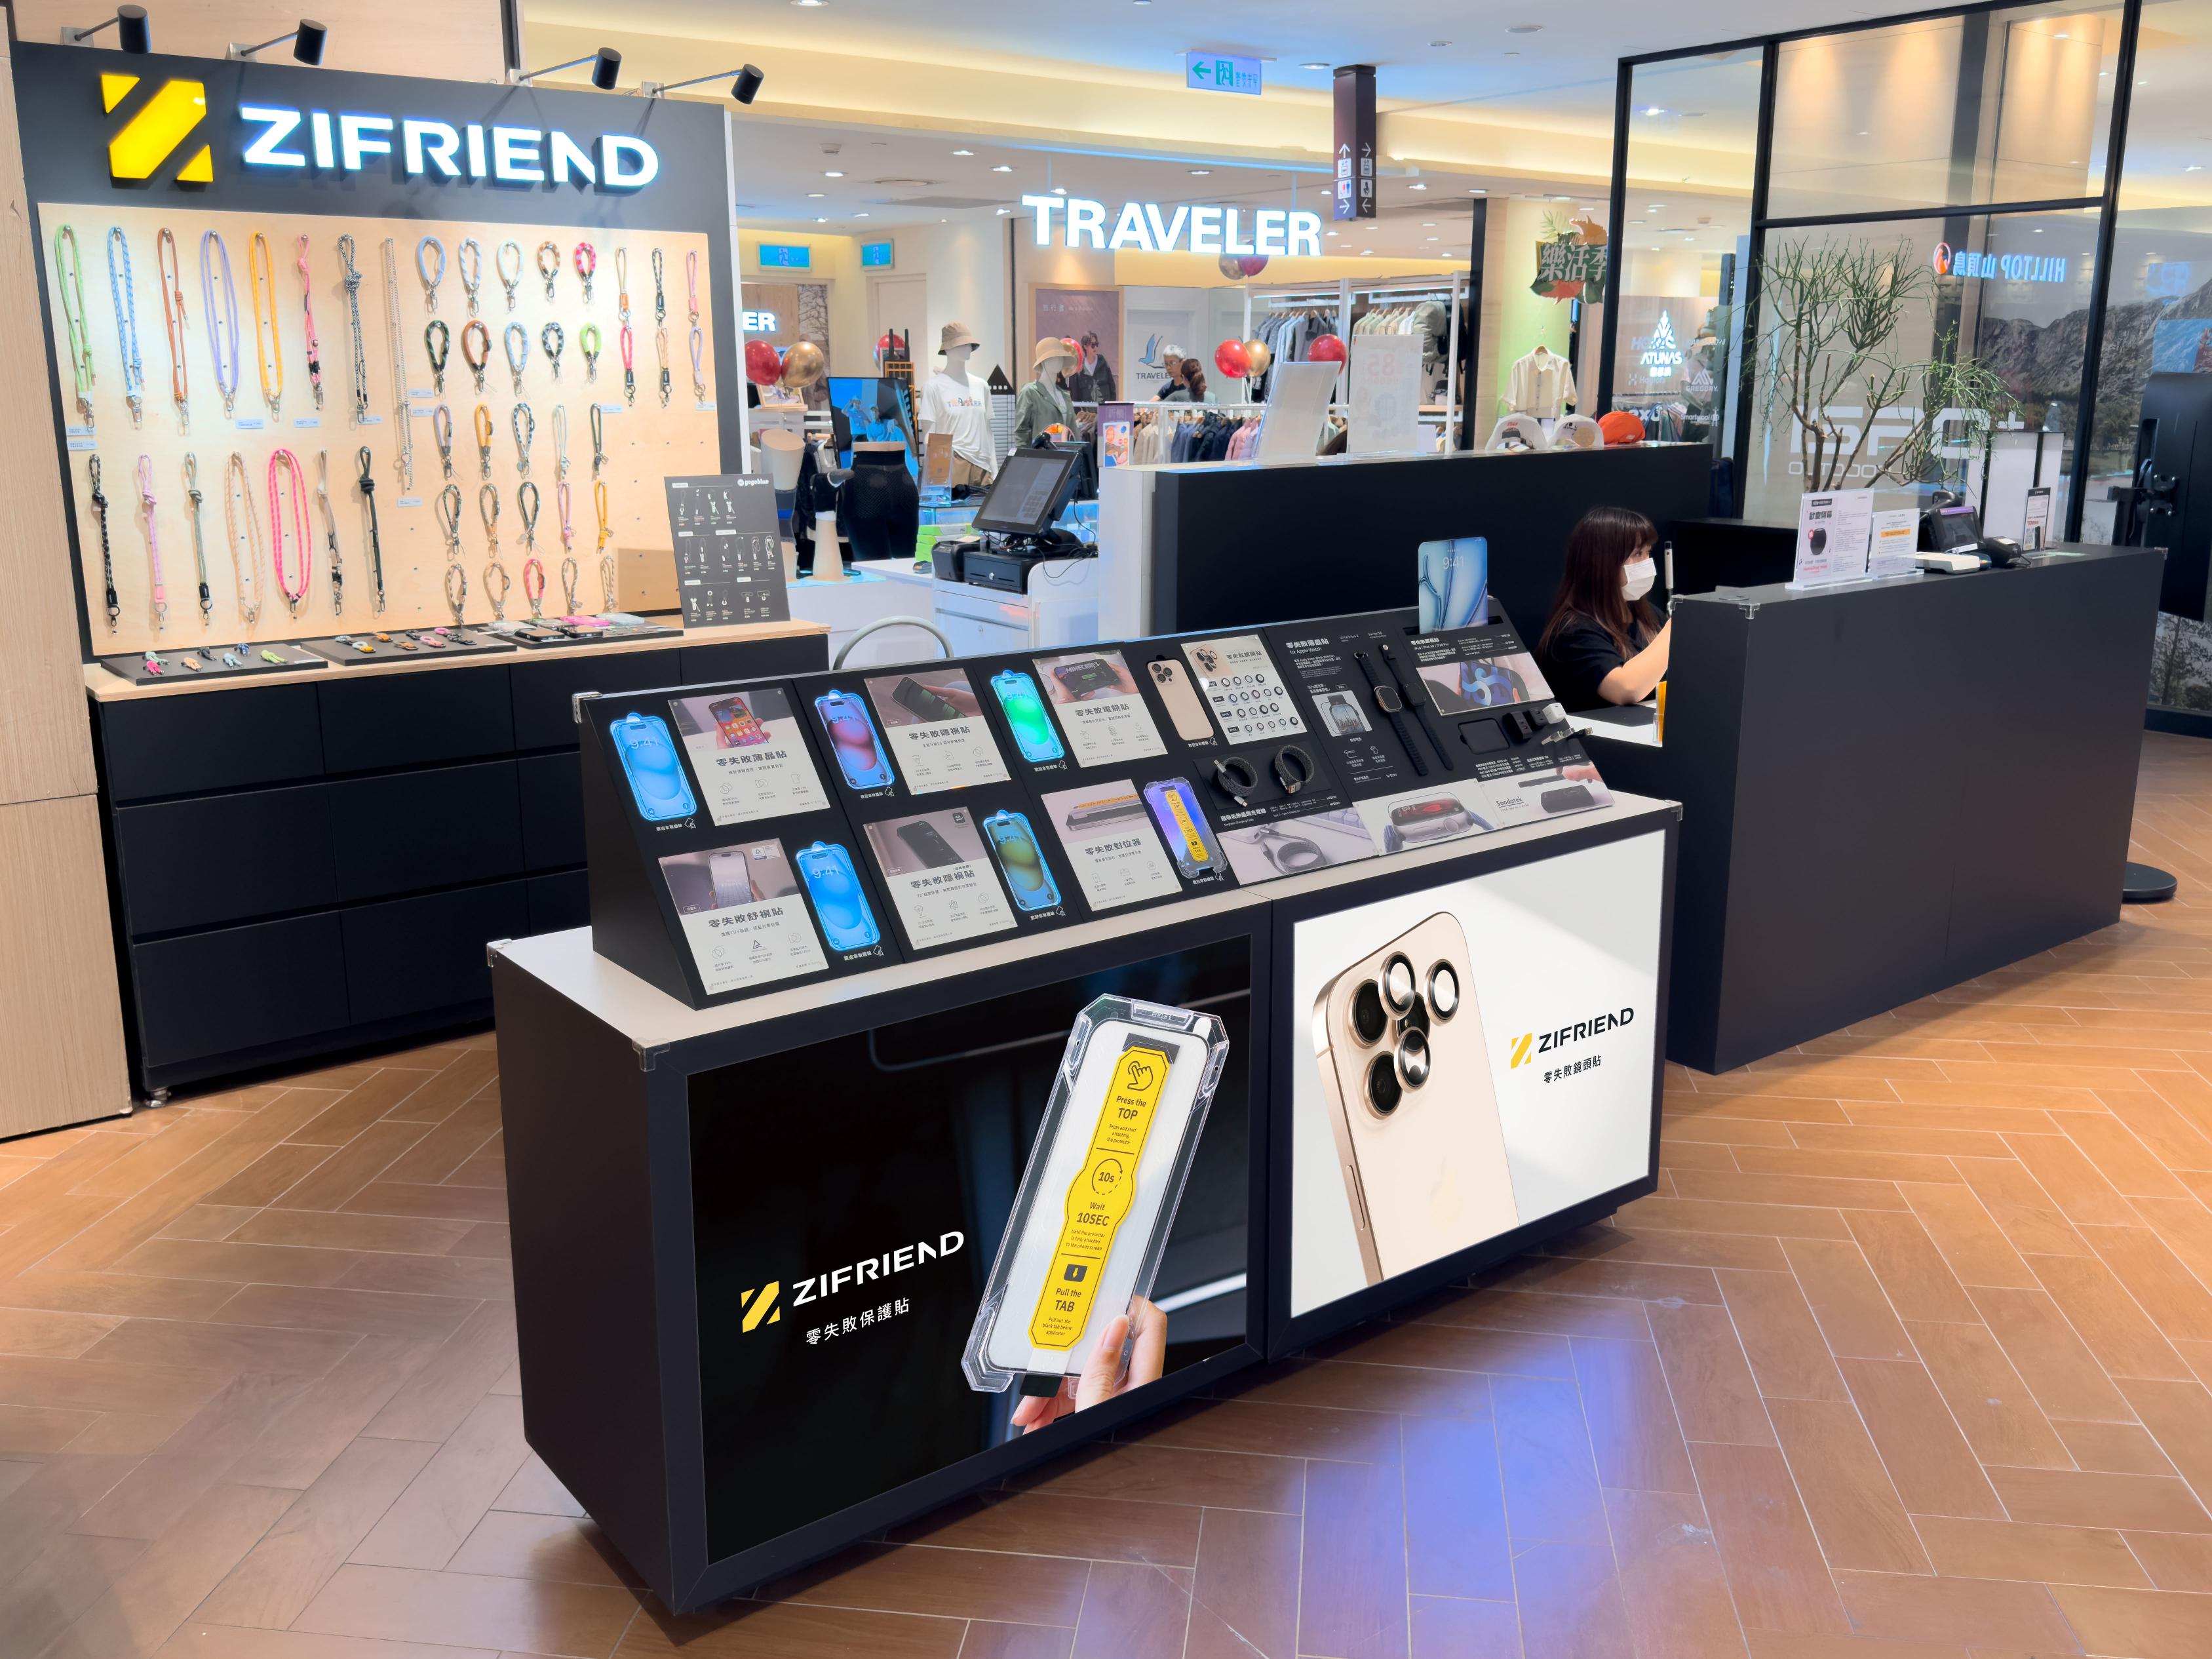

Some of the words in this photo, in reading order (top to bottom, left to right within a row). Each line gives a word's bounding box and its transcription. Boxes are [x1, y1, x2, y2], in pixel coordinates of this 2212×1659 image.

[239, 105, 659, 189] ZIFRIEND
[1021, 195, 1322, 256] TRAVELER
[1539, 243, 1608, 281] 樂活季
[1640, 351, 1683, 365] ATUNAS
[1443, 555, 1464, 570] 9:41
[630, 737, 659, 749] 9:41
[716, 751, 787, 766] 零失敗薄晶貼
[1496, 796, 1523, 807] Soodatek
[1085, 838, 1141, 855] 零失敗對位器
[812, 865, 840, 879] 9:41
[910, 870, 975, 889] 零失敗隱視貼
[708, 907, 783, 927] 零失敗舒視貼
[1538, 1007, 1635, 1053] ZIFRIEND
[1543, 1055, 1601, 1083] 零失敗鏡頭貼
[1116, 1095, 1135, 1106] Press
[1136, 1098, 1146, 1107] the
[1118, 1107, 1138, 1120] TOP
[1098, 1171, 1115, 1183] 10s
[1090, 1201, 1105, 1211] Wait
[1076, 1212, 1110, 1226] 10SEC
[793, 1231, 964, 1307] ZIFRIEND
[1055, 1287, 1070, 1297] Pull
[1070, 1289, 1081, 1298] the
[1055, 1300, 1075, 1312] TAB
[805, 1297, 910, 1344] 零失敗保護貼
